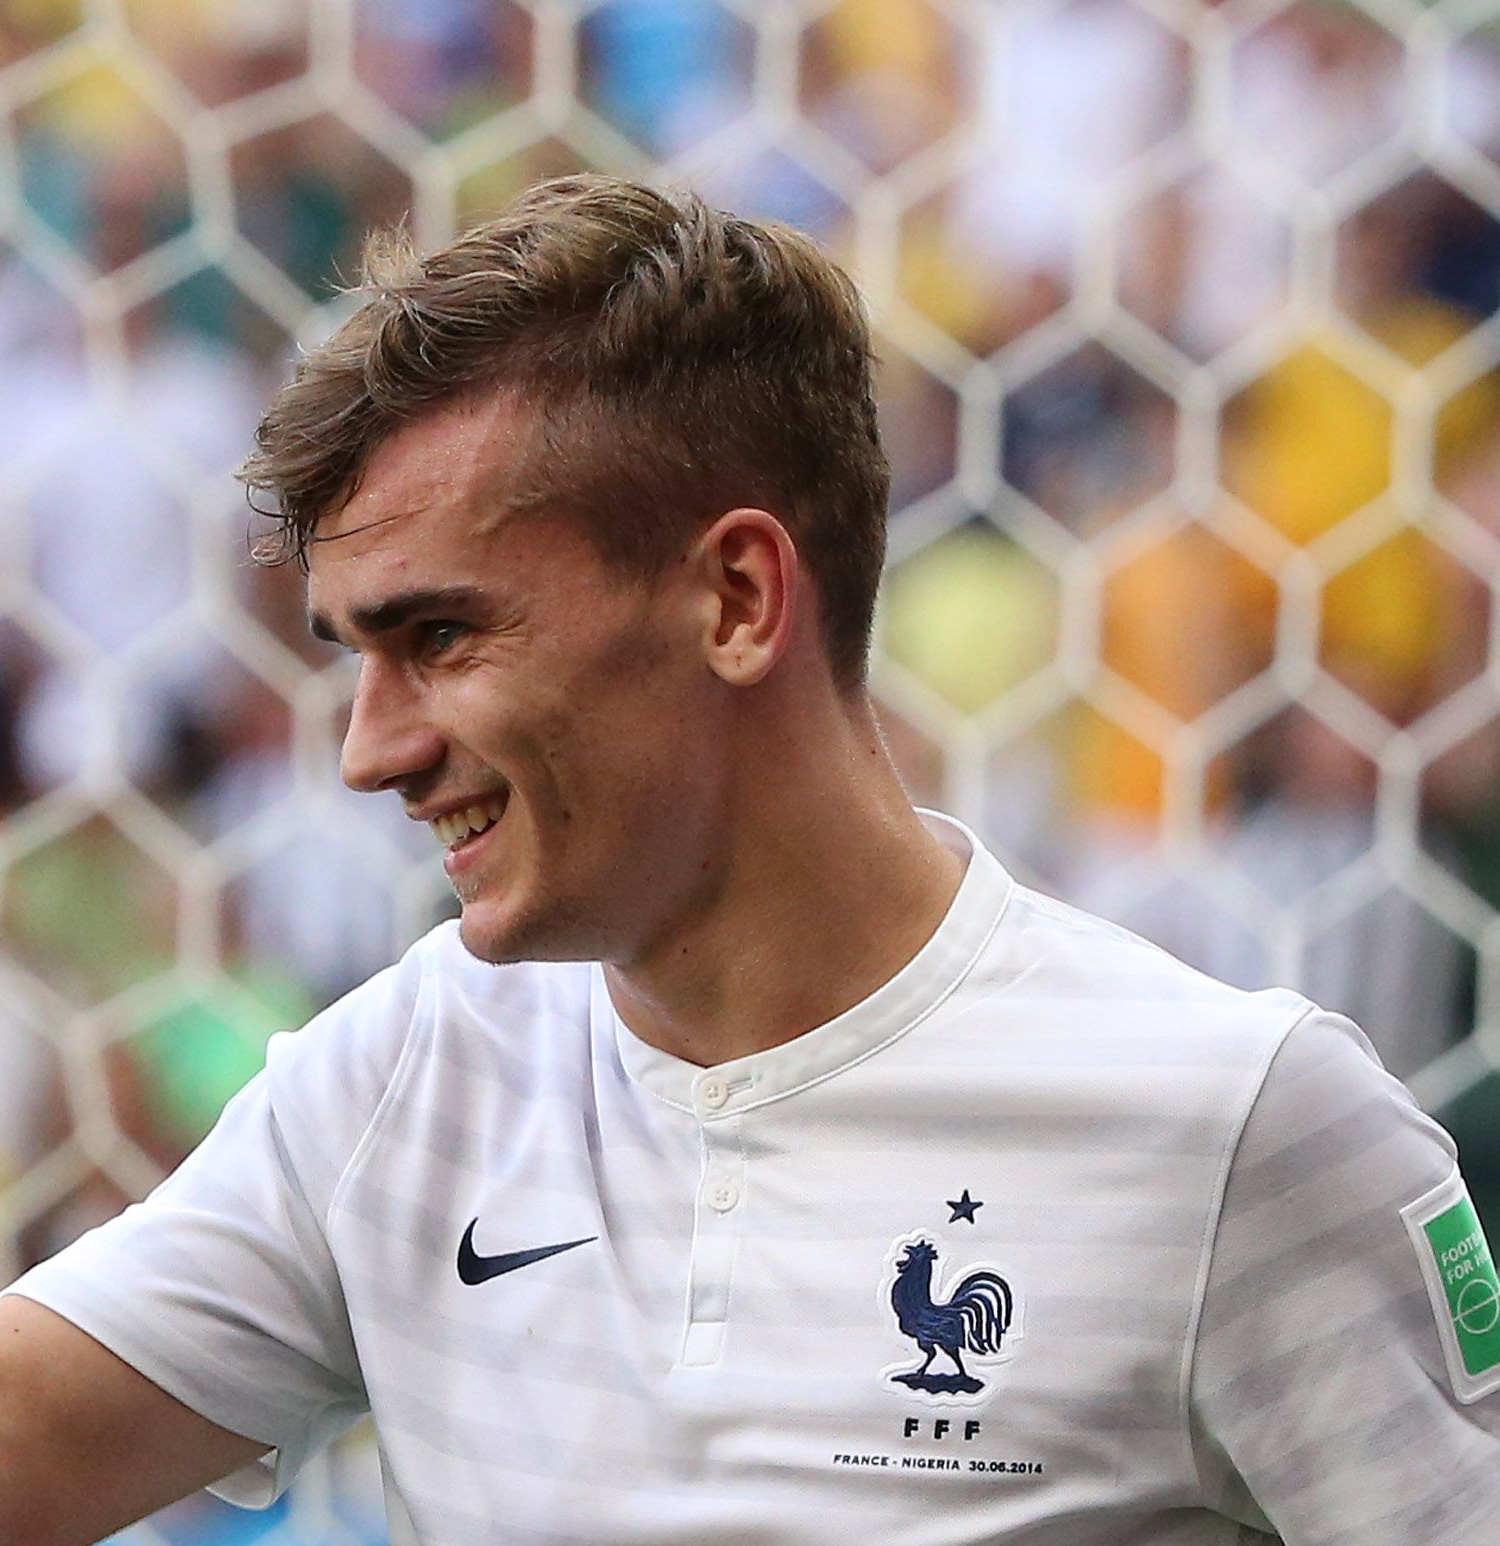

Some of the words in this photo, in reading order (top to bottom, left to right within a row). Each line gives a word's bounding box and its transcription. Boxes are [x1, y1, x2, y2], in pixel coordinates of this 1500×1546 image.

[1447, 1259, 1474, 1284] FOR
[833, 1454, 889, 1467] FRANCE
[902, 1457, 960, 1470] NIGERIA
[969, 1460, 1043, 1475] 30.06.2014
